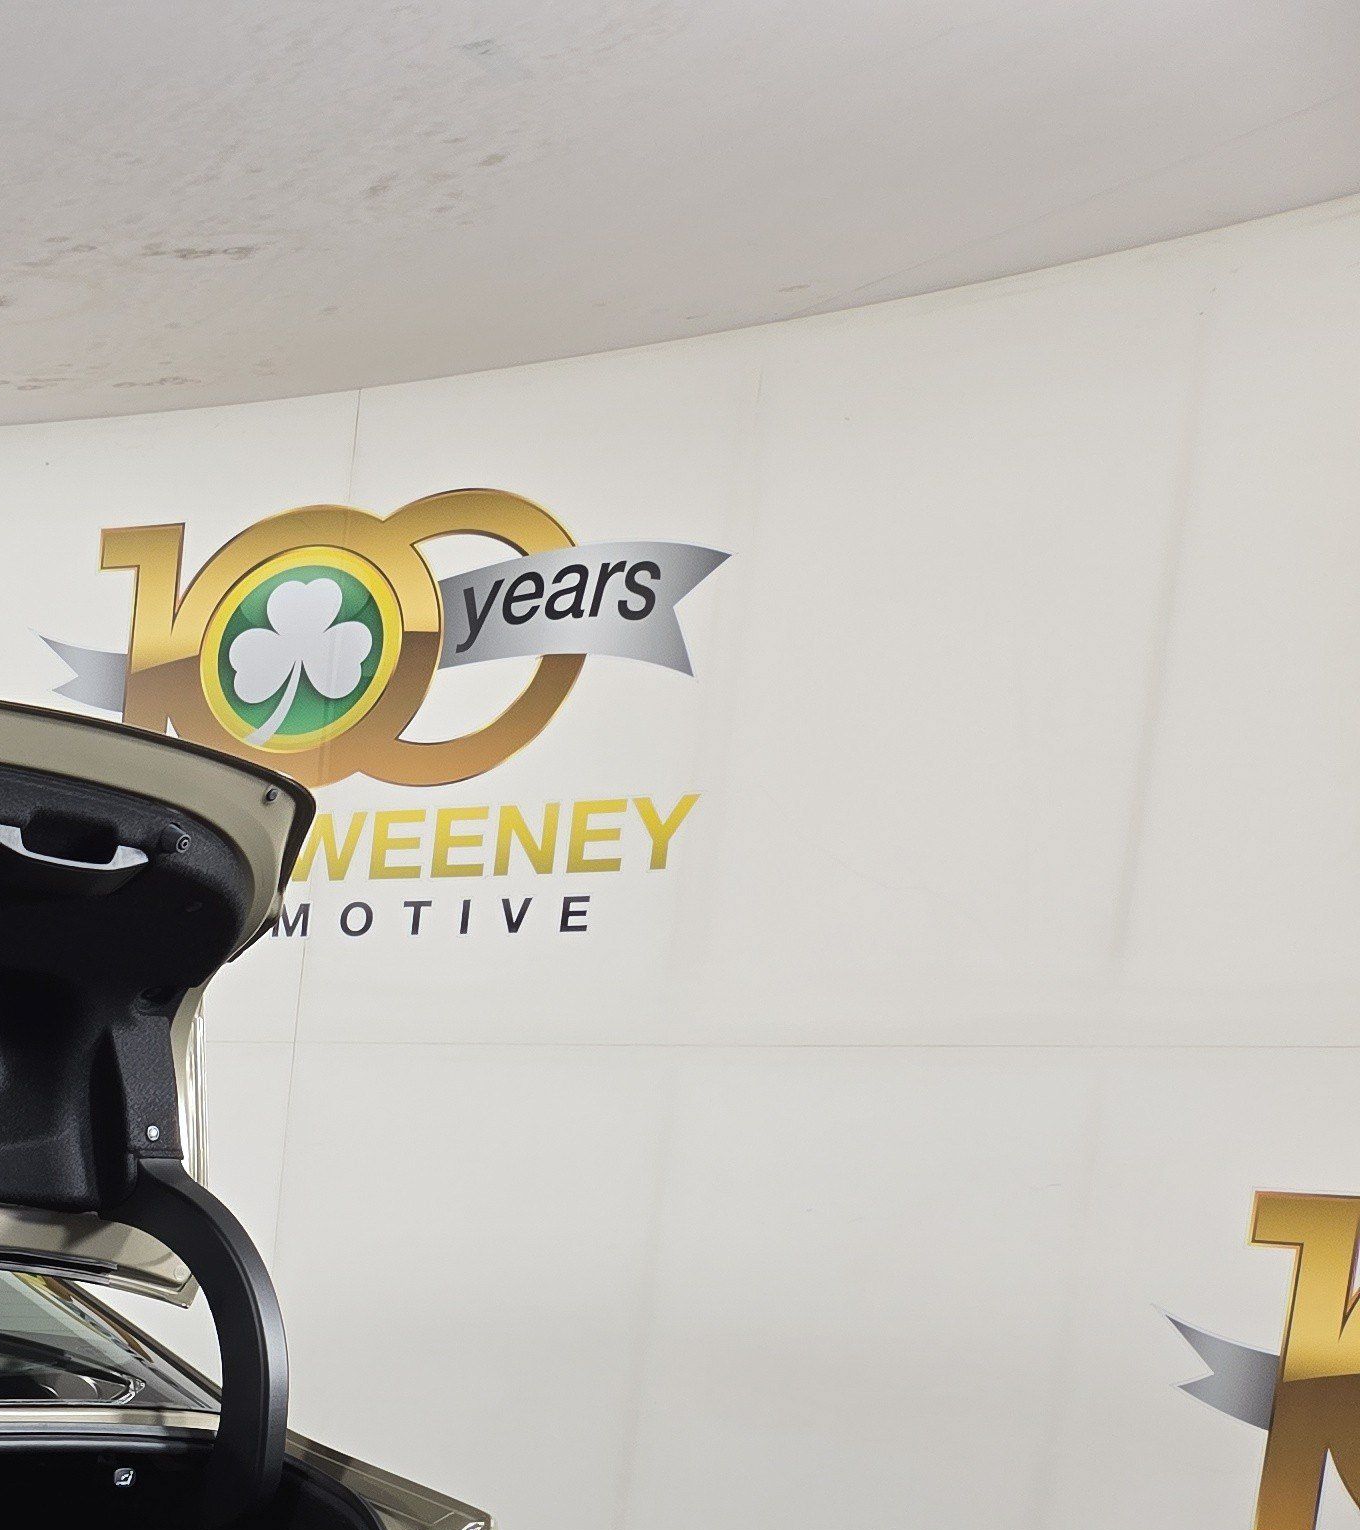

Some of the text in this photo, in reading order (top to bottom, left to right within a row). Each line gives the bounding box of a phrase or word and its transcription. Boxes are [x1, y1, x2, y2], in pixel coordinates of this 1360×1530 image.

[454, 559, 661, 655] years
[290, 793, 702, 883] WEENEY
[271, 895, 592, 938] MOTIVE
